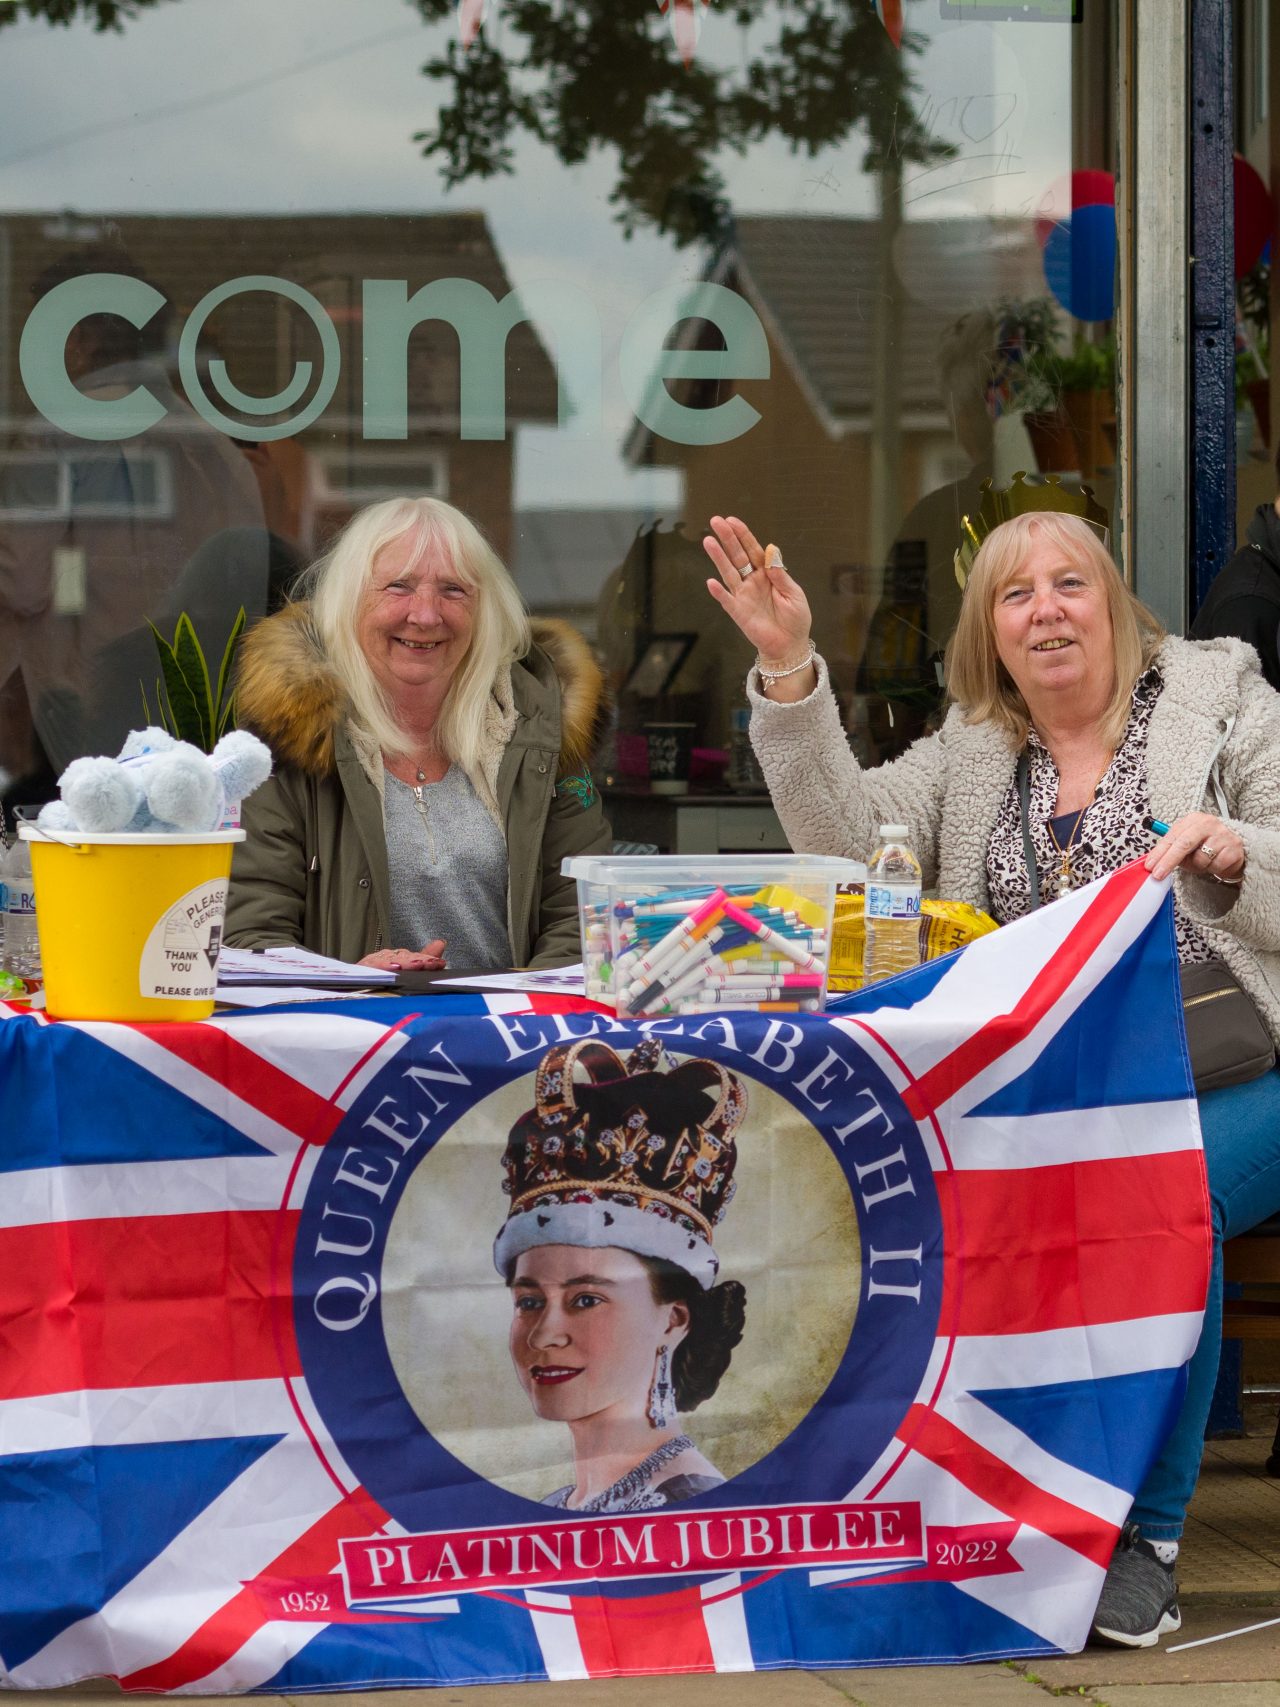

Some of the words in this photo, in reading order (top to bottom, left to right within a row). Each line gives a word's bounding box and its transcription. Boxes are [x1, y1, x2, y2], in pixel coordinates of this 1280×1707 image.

[19, 273, 770, 446] come
[186, 891, 224, 920] PLEASE
[165, 950, 199, 961] THANK
[170, 962, 192, 972] YOU
[154, 986, 191, 996] PLEASE
[313, 1041, 472, 1331] QUEEN
[868, 1242, 923, 1304] II
[363, 1526, 660, 1588] PLATINUM
[670, 1509, 905, 1568] JUBILEE
[935, 1538, 998, 1567] 2022
[280, 1590, 330, 1613] 1952
